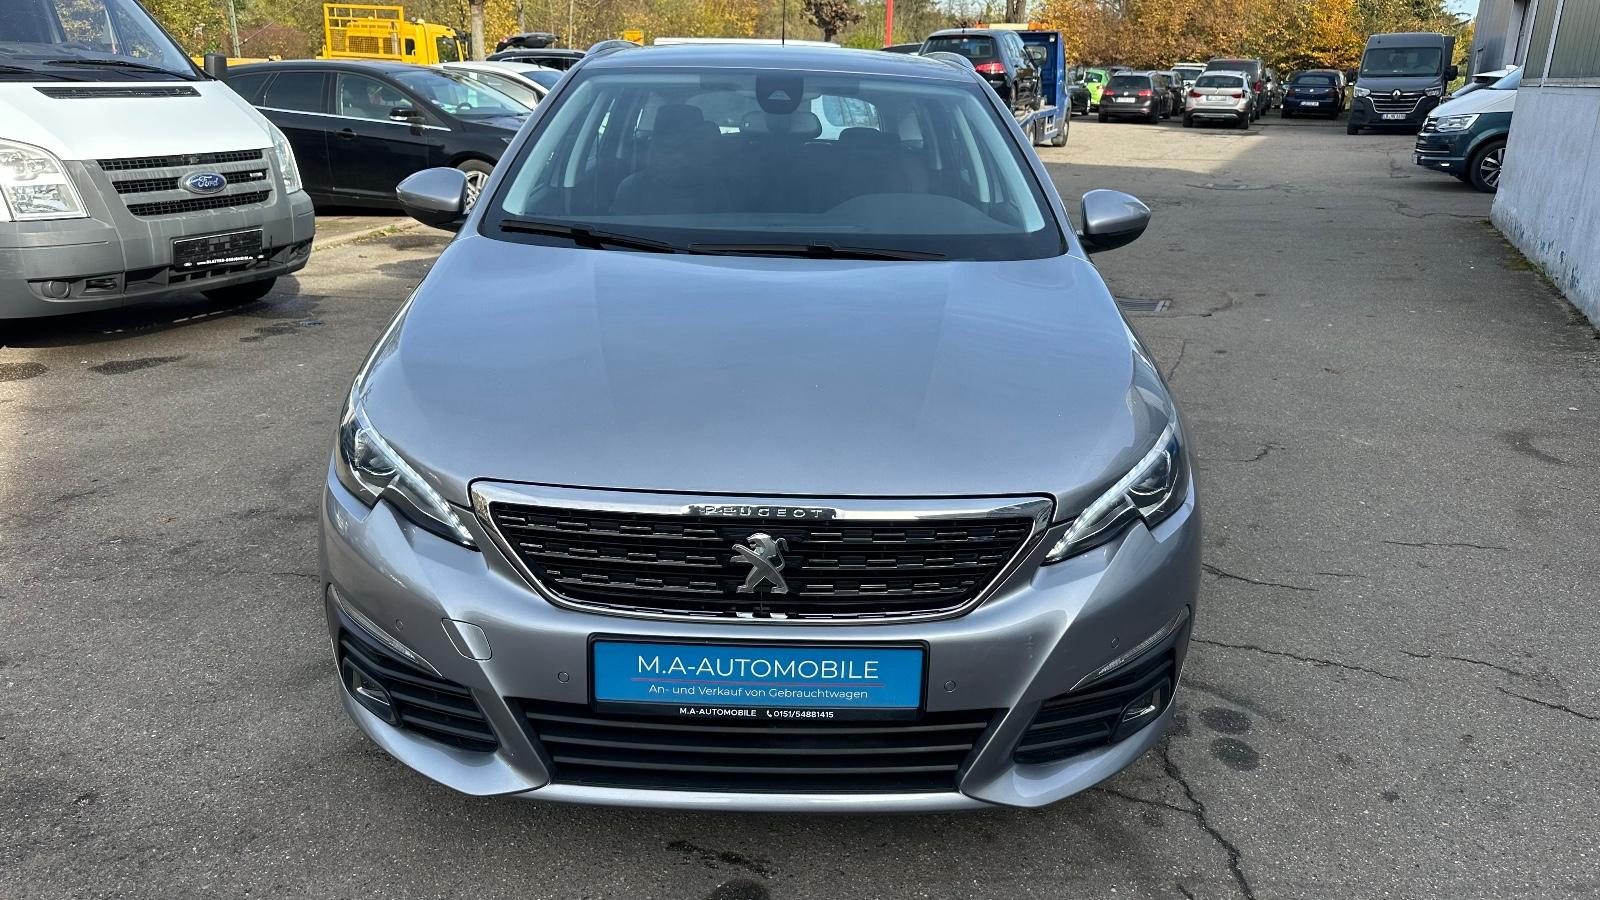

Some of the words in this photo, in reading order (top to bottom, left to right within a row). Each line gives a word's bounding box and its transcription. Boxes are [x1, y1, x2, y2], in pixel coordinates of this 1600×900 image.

[190, 175, 219, 187] Ford
[703, 505, 823, 518] PEUGEOT
[637, 654, 880, 679] M.A-AUTOMOBILE
[648, 684, 670, 694] An-
[672, 685, 695, 696] und
[698, 686, 743, 697] Verkauf
[744, 689, 766, 698] von
[768, 687, 868, 701] Gebrauchtwagen
[679, 706, 757, 717] M.A-AUTOMOBILE
[773, 709, 834, 718] 0151/54881415
